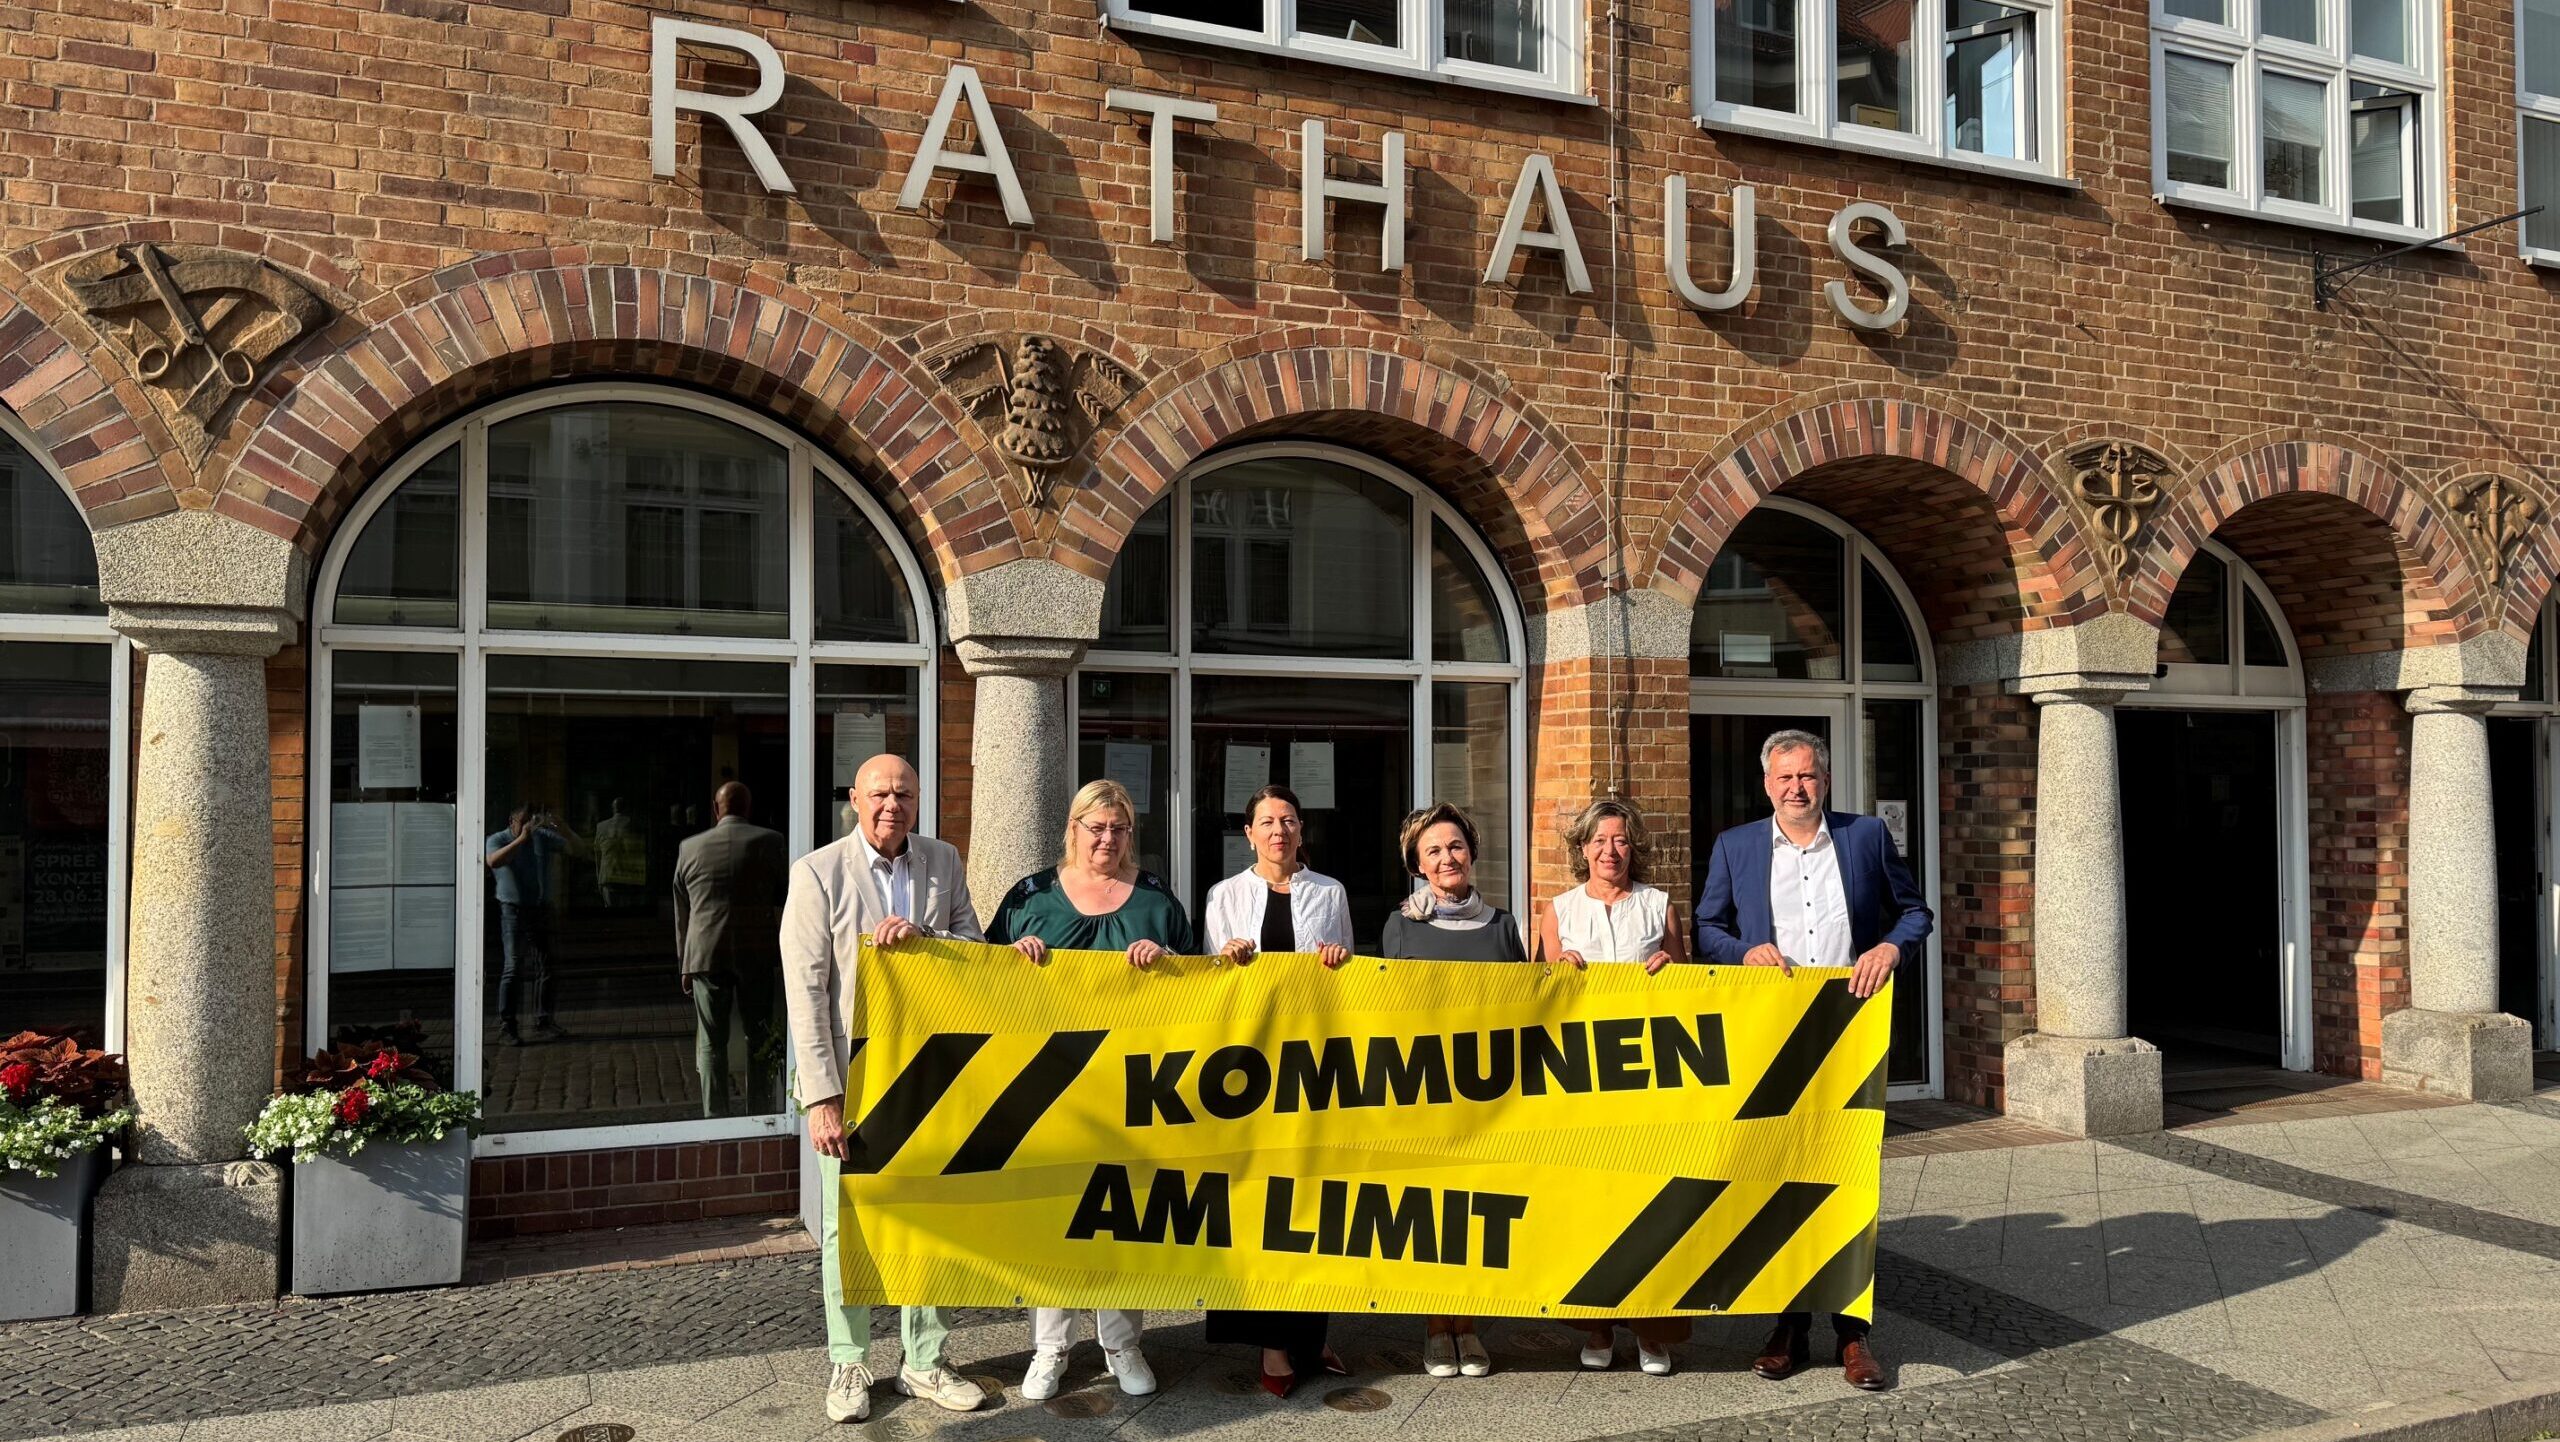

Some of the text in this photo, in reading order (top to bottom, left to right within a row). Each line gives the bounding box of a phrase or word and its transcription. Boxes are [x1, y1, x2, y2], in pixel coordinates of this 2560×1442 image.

[650, 15, 1912, 331] RATHAUS
[34, 854, 97, 868] SPREE
[34, 871, 107, 886] KONZE
[33, 889, 104, 904] 28.06.2
[1124, 1013, 1731, 1127] KOMMUNEN
[1065, 1162, 1529, 1269] AM LIMIT
